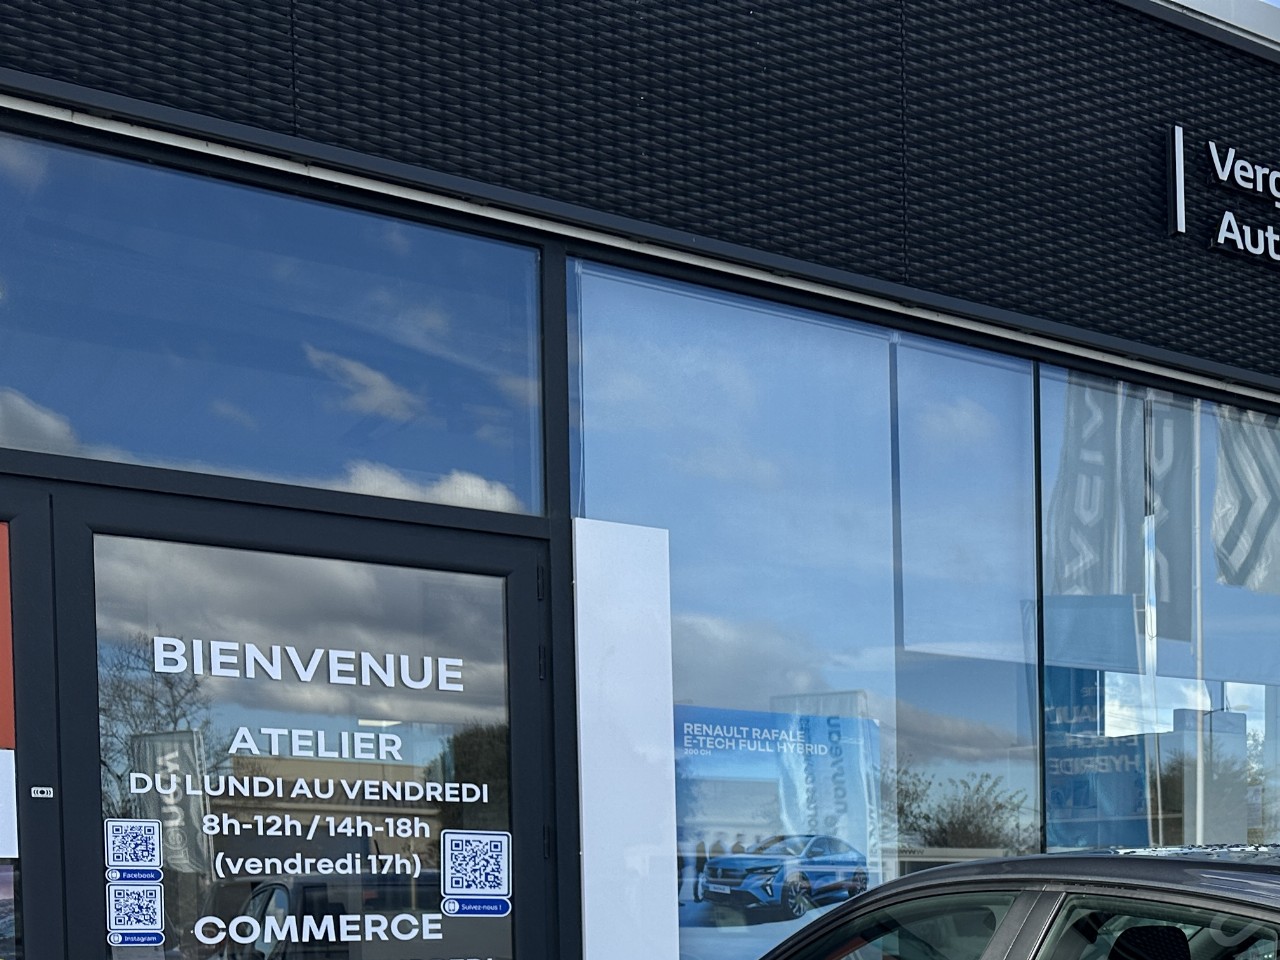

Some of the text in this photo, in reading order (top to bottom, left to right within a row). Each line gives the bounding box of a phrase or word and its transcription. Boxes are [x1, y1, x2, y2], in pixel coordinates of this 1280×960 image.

[153, 636, 464, 692] BIENVENUE
[228, 726, 403, 760] ATELIER
[684, 723, 805, 743] RENAULT RAFALE
[684, 735, 828, 755] E-TECH FULL HYBRID
[129, 773, 489, 803] DU LUNDI AU VENDREDI
[202, 813, 430, 840] 8h-12h / 14h-18h
[215, 852, 422, 878] (vendredi 17h)
[124, 935, 157, 943] Instagram
[194, 913, 443, 945] COMMERCE
